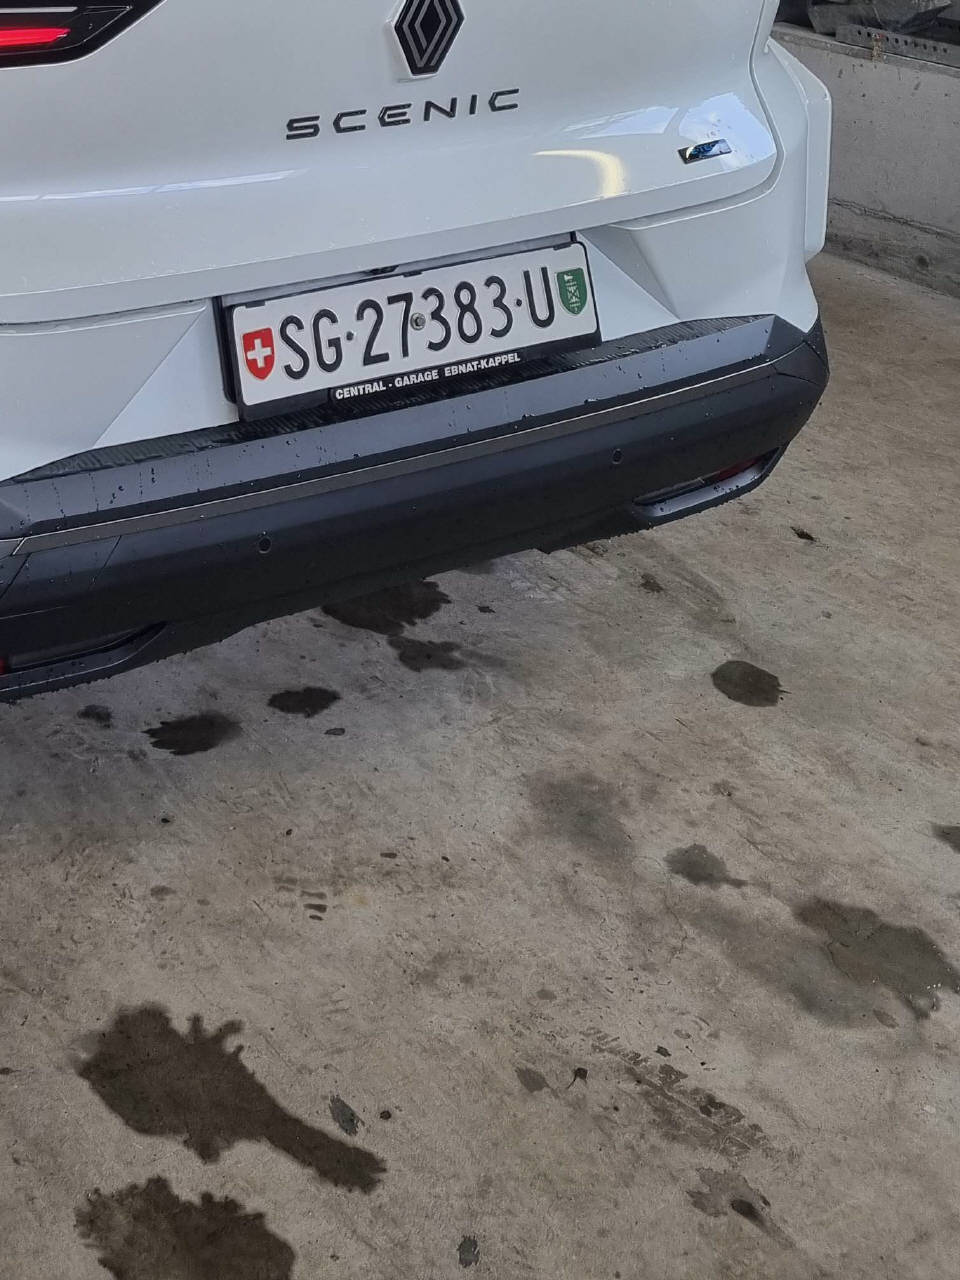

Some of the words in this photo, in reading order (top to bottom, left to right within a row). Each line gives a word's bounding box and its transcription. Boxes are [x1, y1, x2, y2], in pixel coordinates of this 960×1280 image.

[286, 88, 520, 140] SCENIC
[335, 379, 387, 400] CENTRAL
[394, 369, 440, 388] GARAGE
[444, 352, 521, 377] EBNAT-KAPPEL
